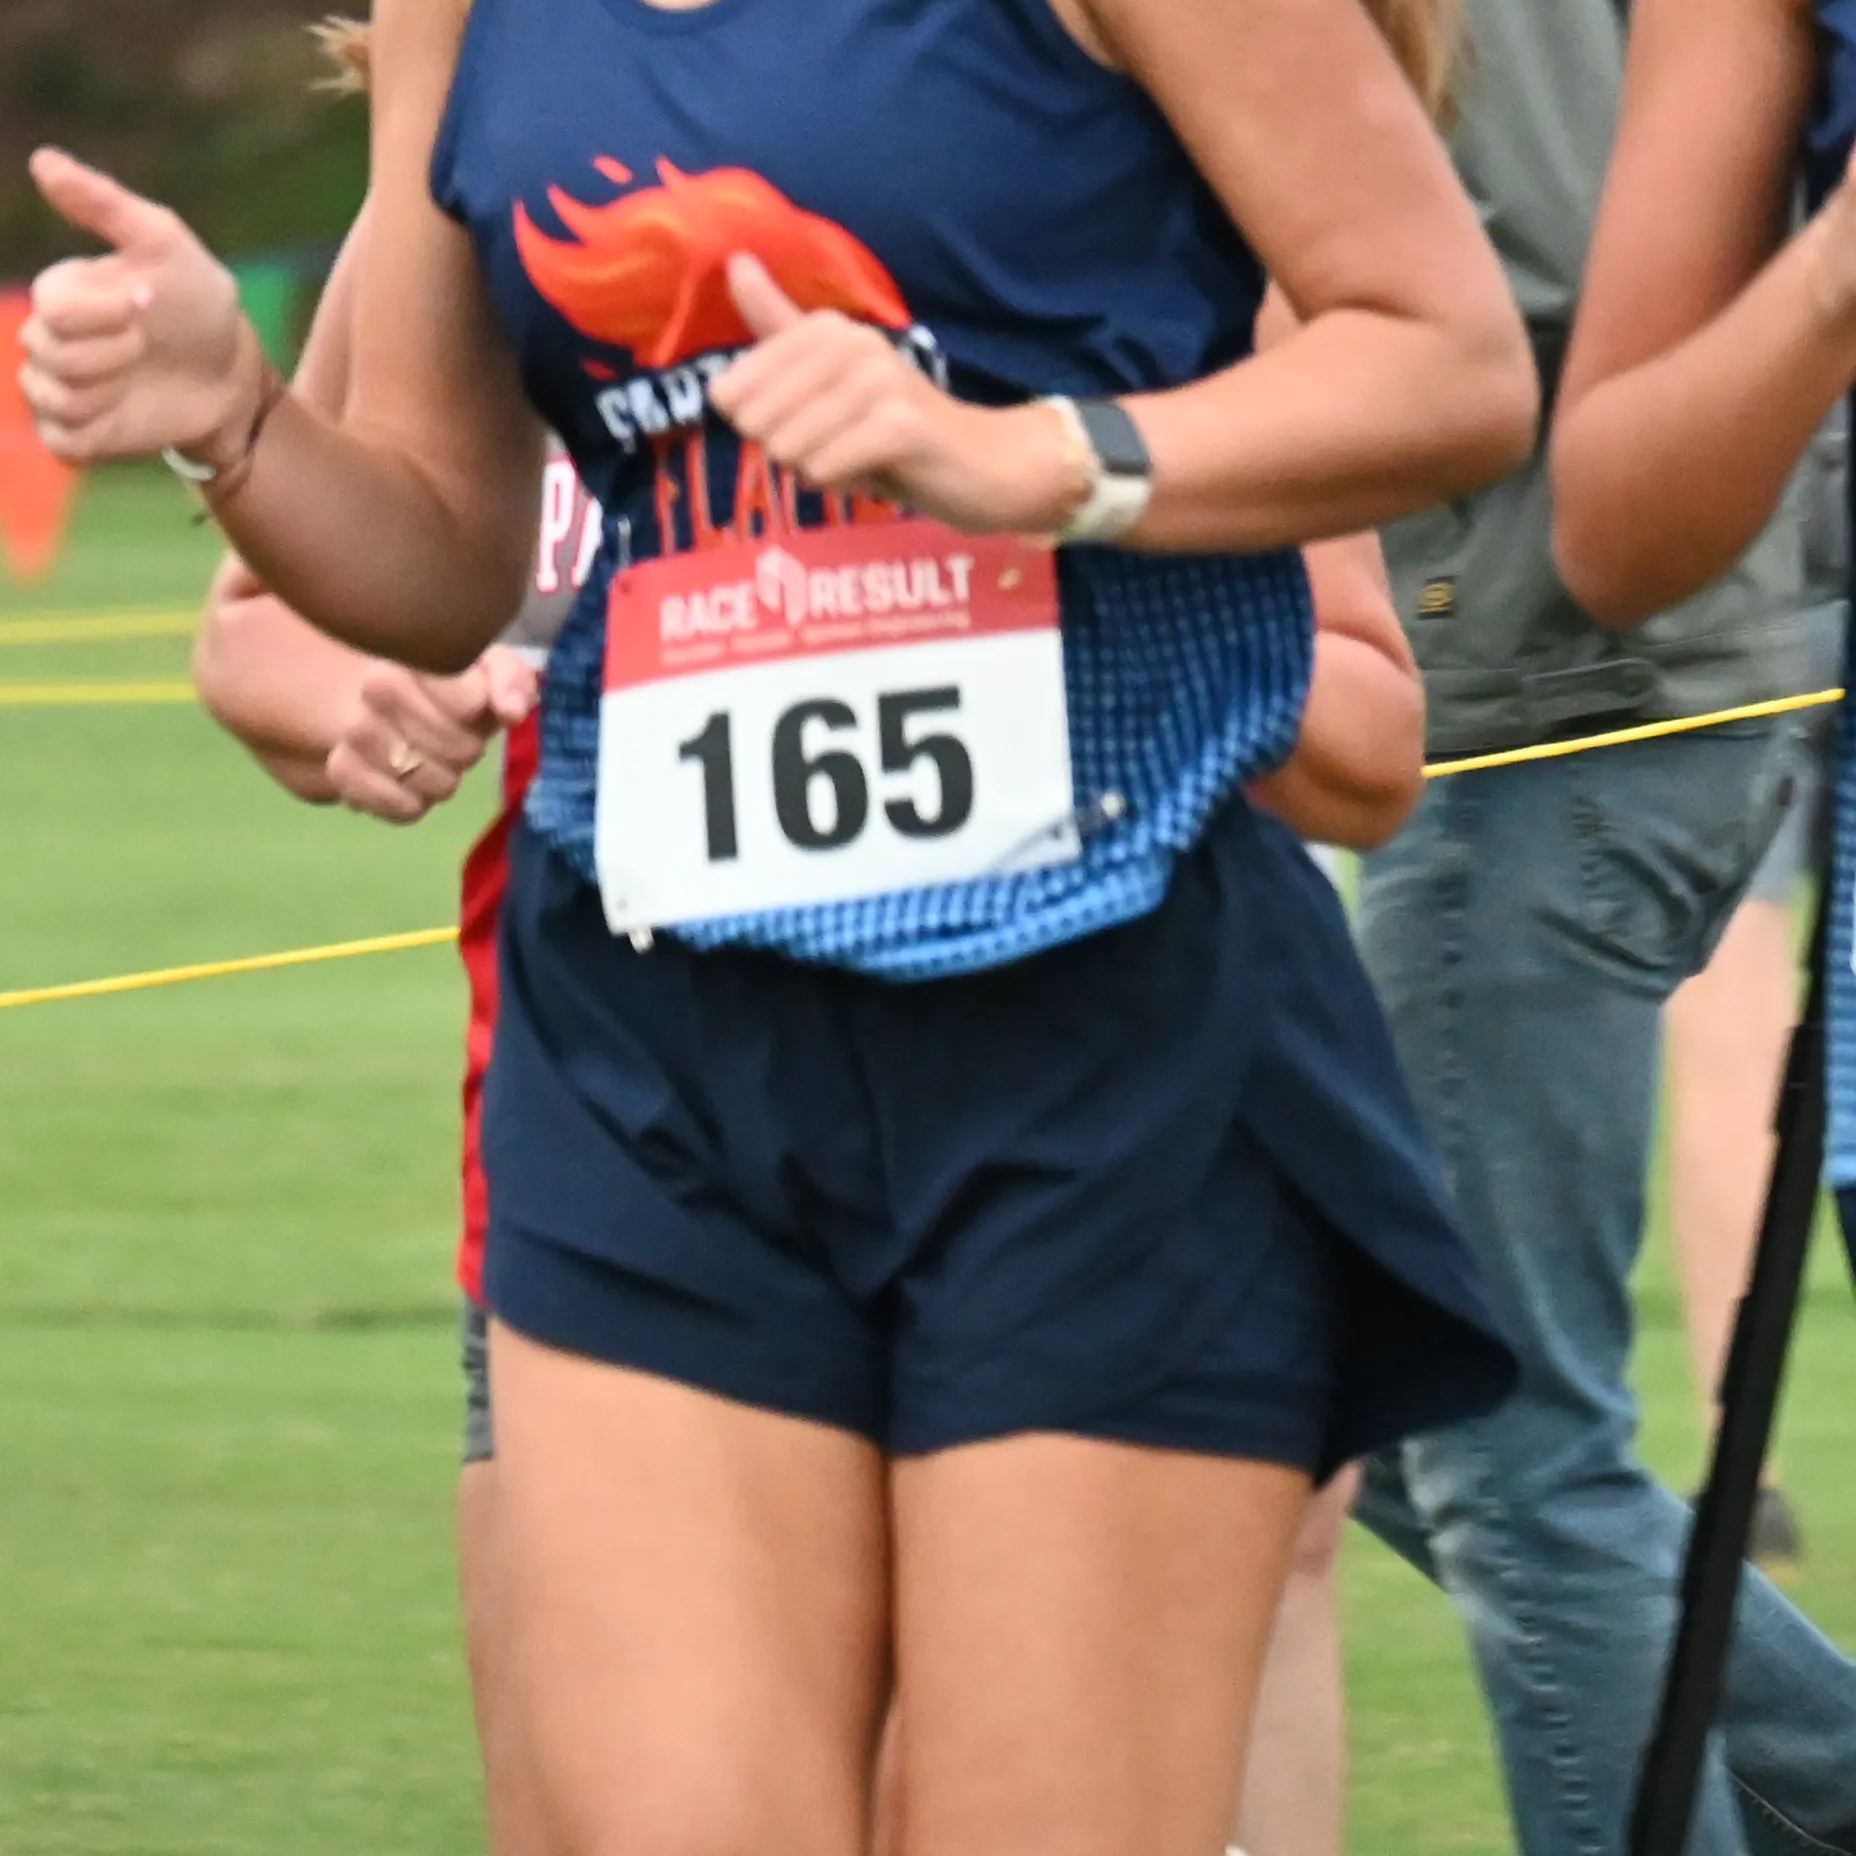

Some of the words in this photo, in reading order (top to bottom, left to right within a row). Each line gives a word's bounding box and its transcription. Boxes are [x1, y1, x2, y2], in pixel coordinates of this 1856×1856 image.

[660, 582, 758, 642] RACE
[808, 552, 976, 619] RESULT
[677, 684, 975, 864] 165
